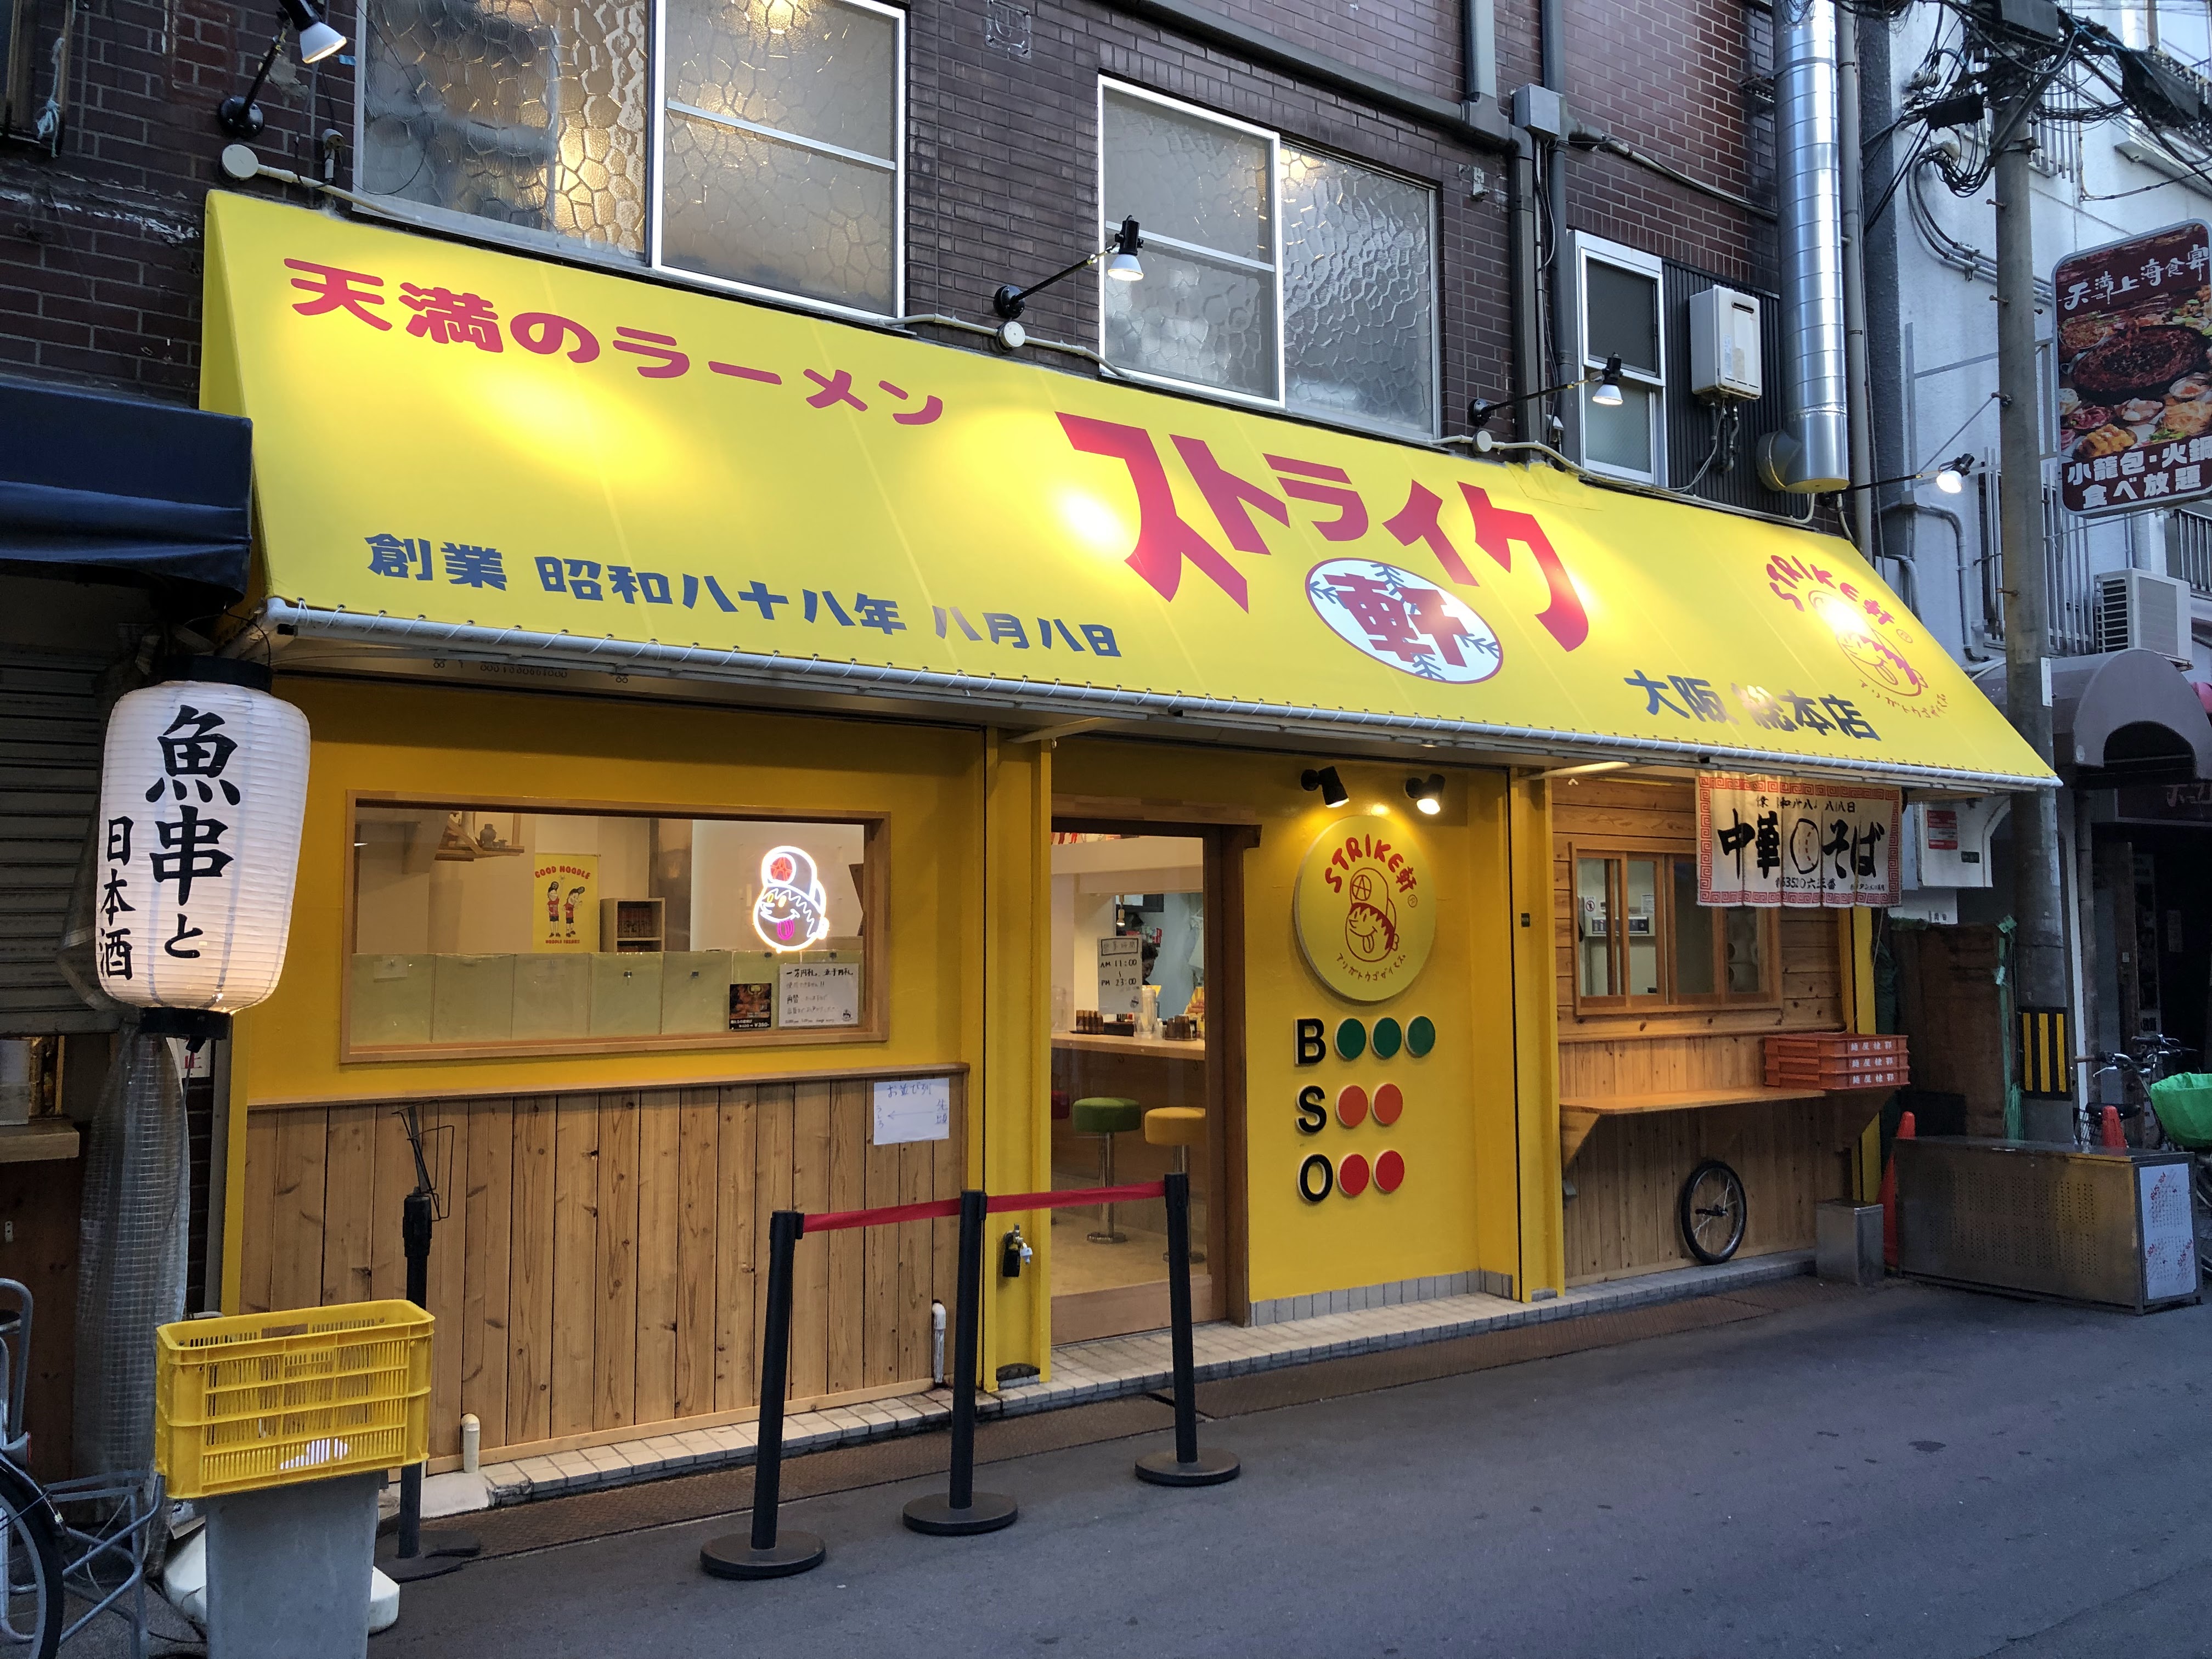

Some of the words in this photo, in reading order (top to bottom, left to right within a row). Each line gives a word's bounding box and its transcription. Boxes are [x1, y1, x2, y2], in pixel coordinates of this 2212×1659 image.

[284, 258, 943, 426] 天満のラーメン
[2083, 464, 2202, 509] 食べ放題
[1054, 411, 1589, 653] ストライク
[364, 533, 507, 591] 創業
[534, 555, 908, 636] 昭和八十八年
[933, 604, 1123, 658] 八月八日
[1327, 572, 1469, 668] 軒
[1624, 669, 1739, 725] 大阪
[1731, 682, 1882, 741] 総本店
[145, 704, 241, 960] 魚串と
[1822, 819, 1885, 879] そば
[99, 816, 136, 981] 日本酒
[534, 866, 557, 878] GOOD
[559, 865, 591, 879] NOODLE
[1115, 958, 1137, 967] 11:00
[1115, 977, 1137, 986] 23:00
[1294, 1018, 1327, 1066] B
[1296, 1085, 1328, 1133] S
[1297, 1153, 1334, 1203] O
